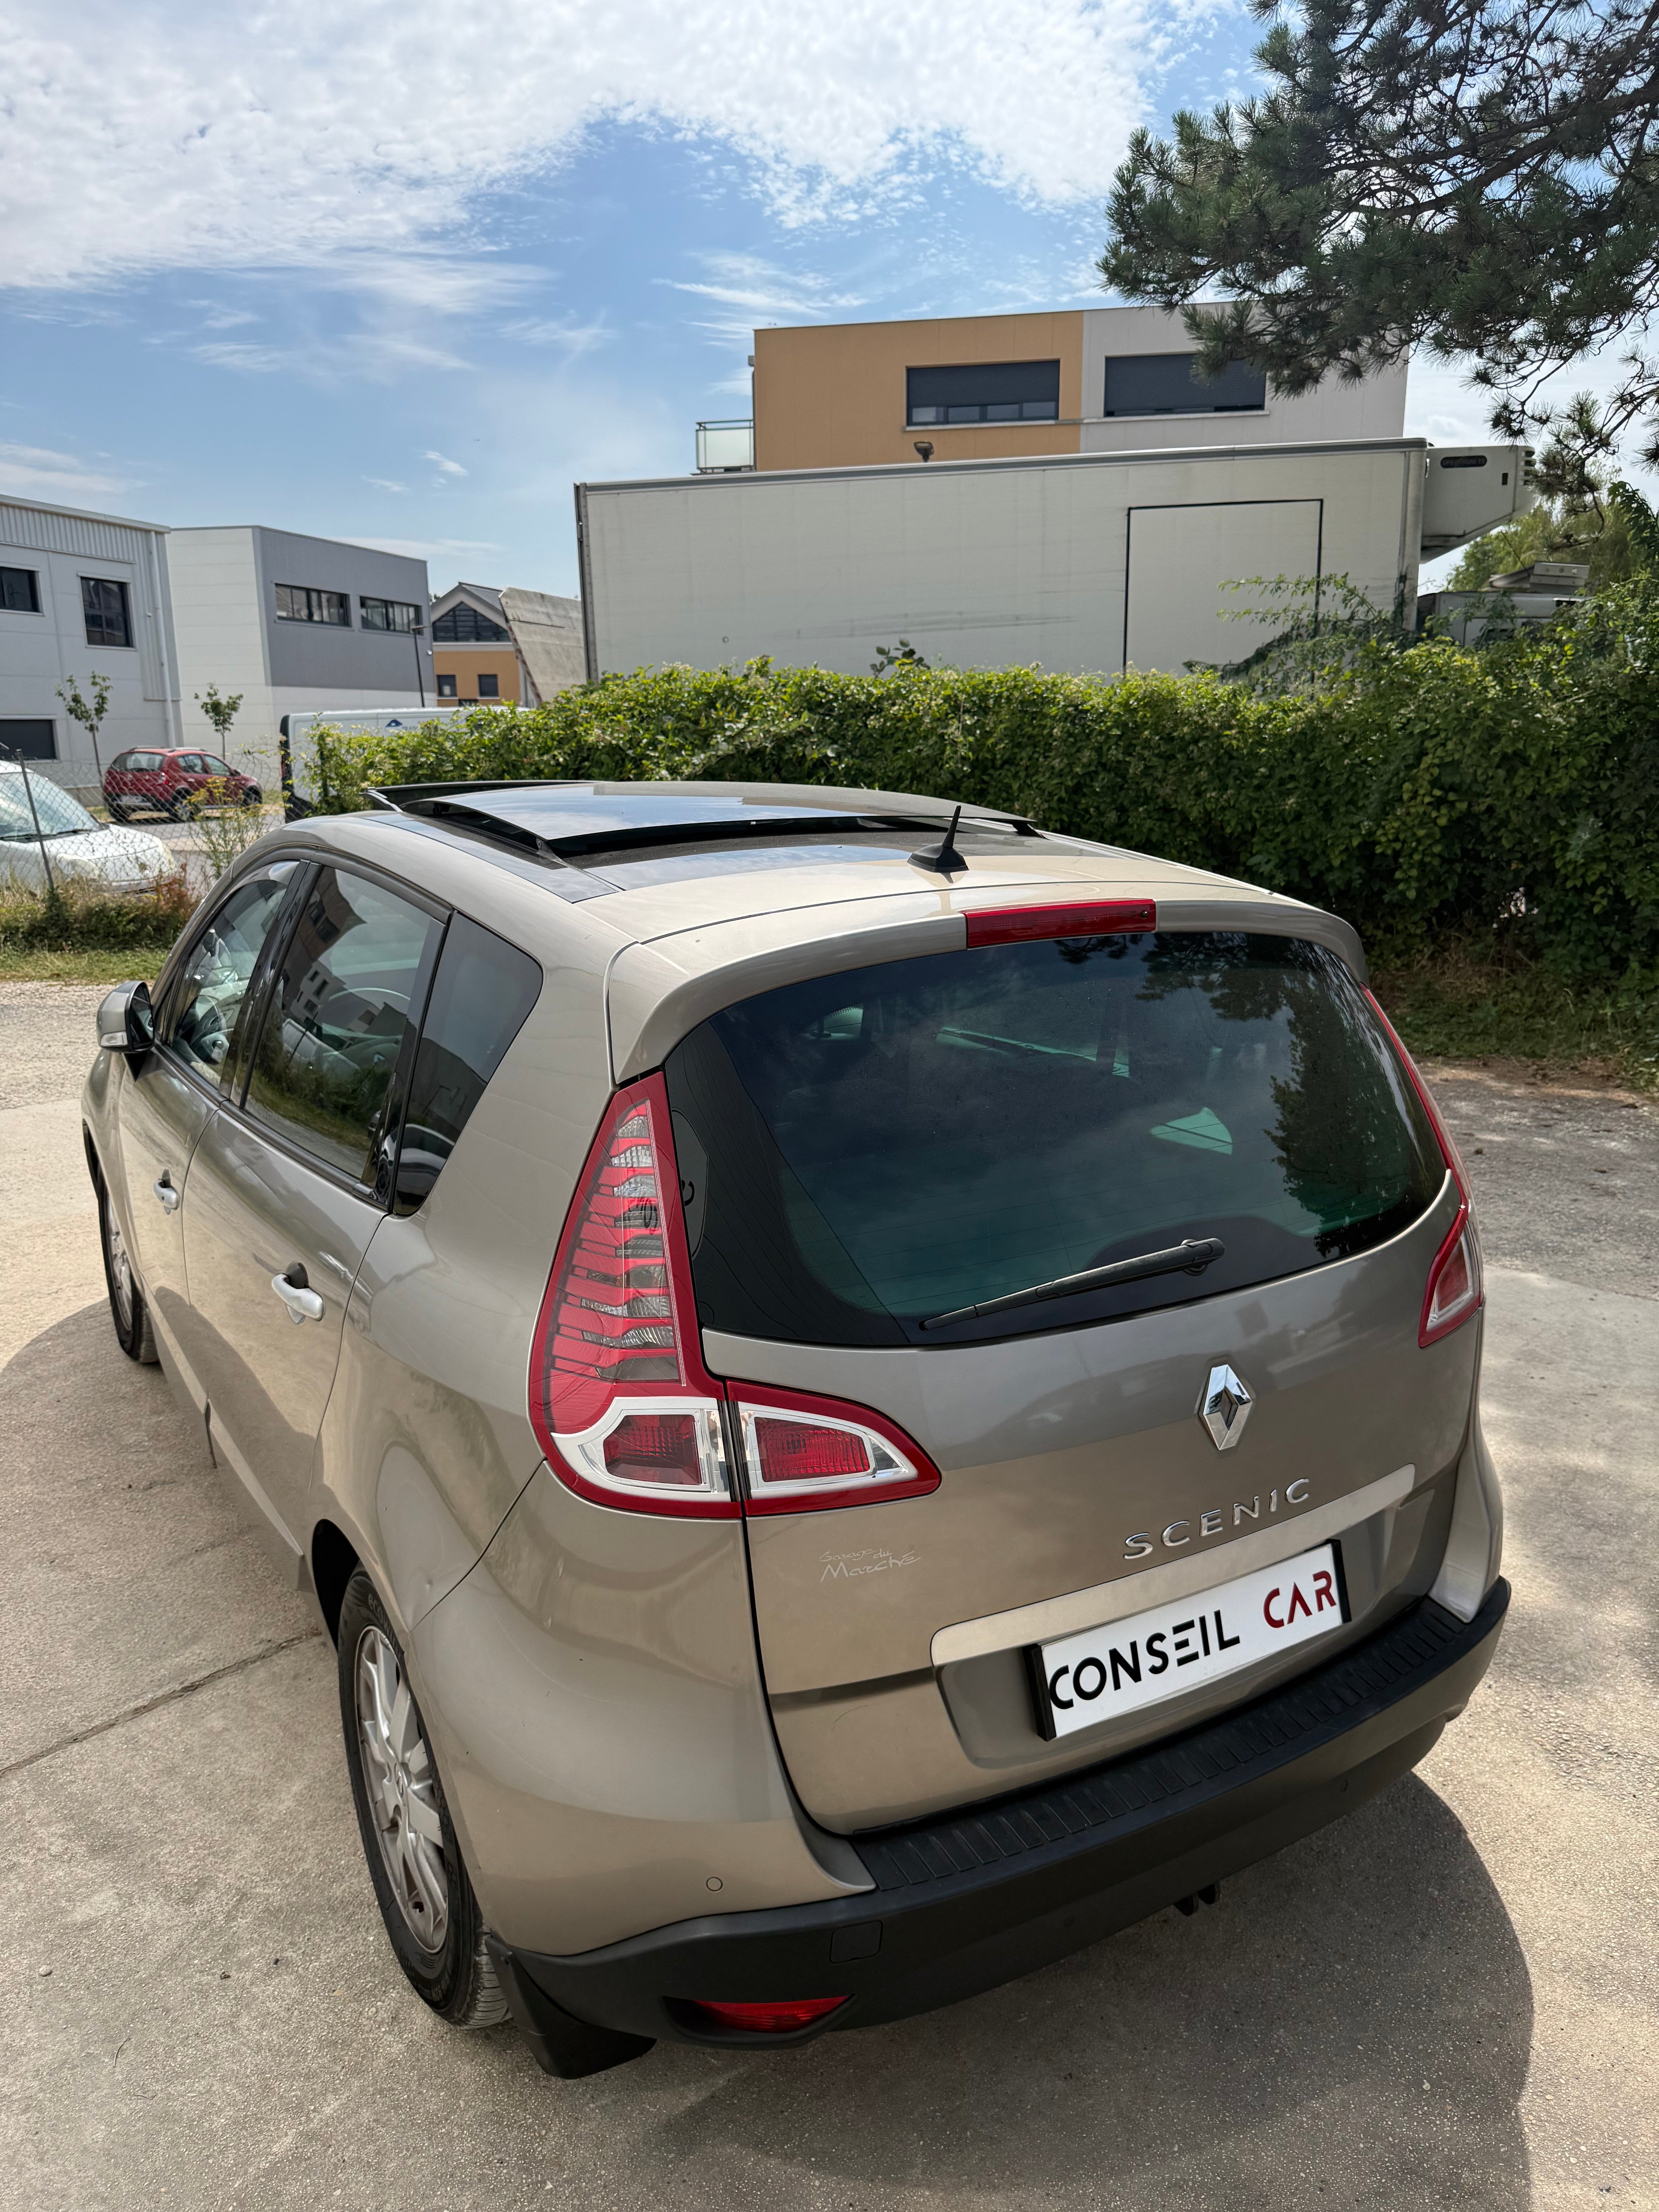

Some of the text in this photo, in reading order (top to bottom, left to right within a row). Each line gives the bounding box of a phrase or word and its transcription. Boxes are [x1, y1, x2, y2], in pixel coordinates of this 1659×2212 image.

[1123, 1478, 1310, 1559] SCENIC
[819, 1548, 892, 1561] Garage du
[820, 1551, 921, 1582] Marché
[1049, 1570, 1337, 1710] CONSEIL CAR
